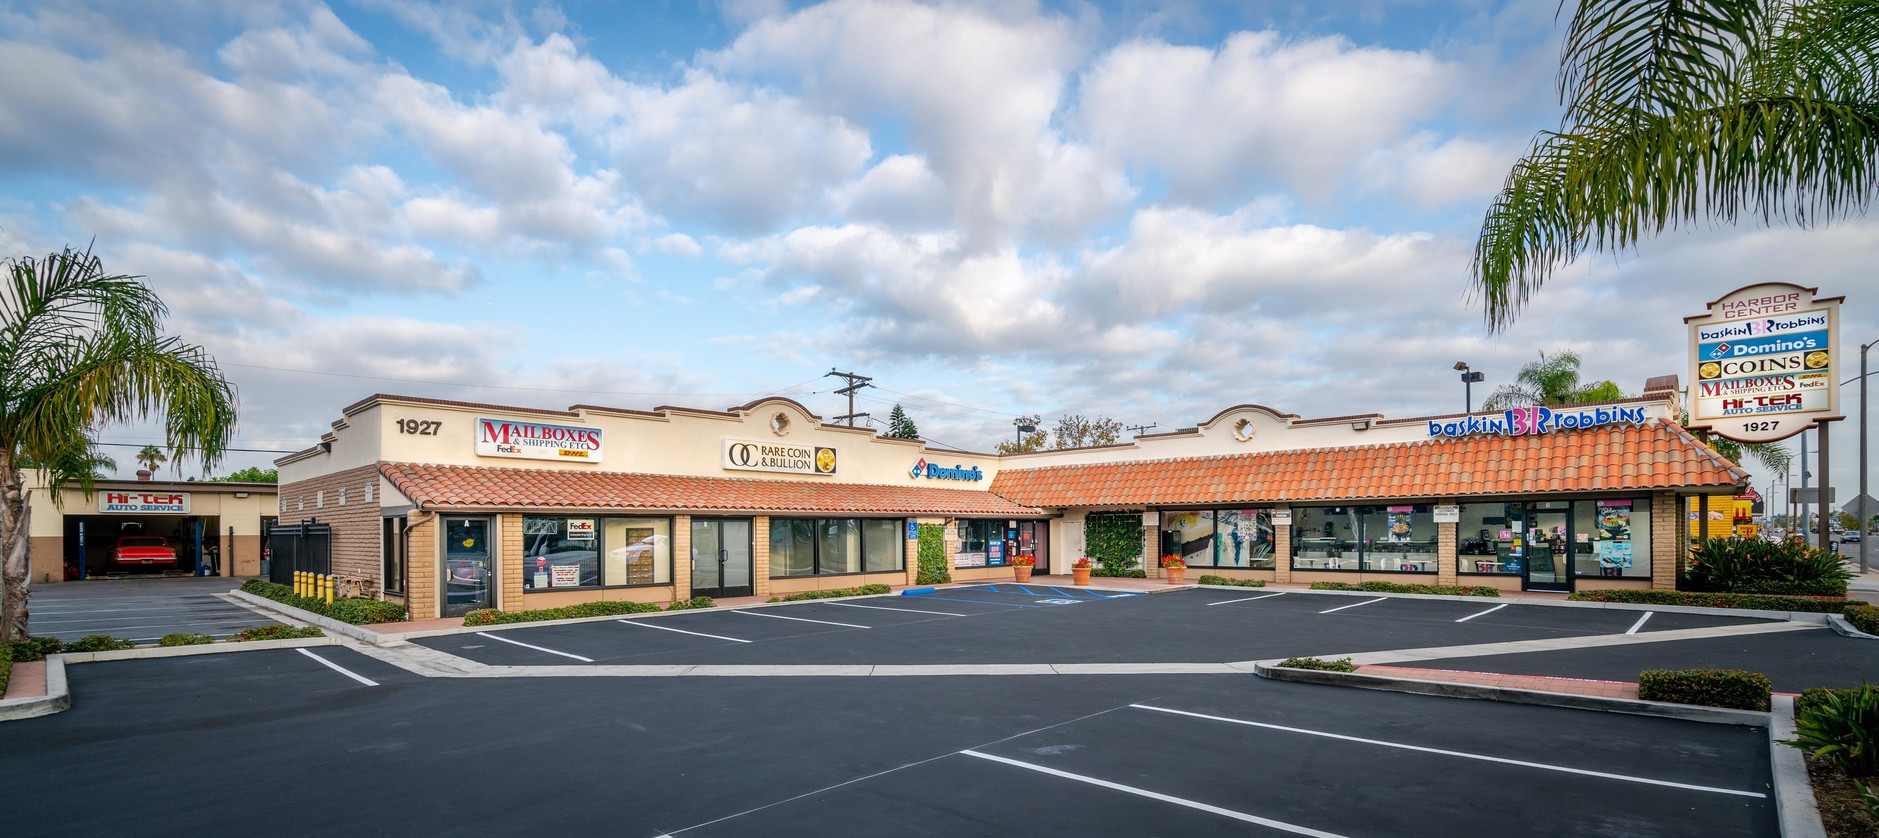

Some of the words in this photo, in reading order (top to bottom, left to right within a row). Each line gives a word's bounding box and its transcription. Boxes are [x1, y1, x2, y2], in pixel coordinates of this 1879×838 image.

[1722, 292, 1800, 311] HARBOR
[1725, 302, 1797, 319] CENTER
[1700, 327, 1746, 340] baskin
[1746, 319, 1775, 336] BR
[1775, 315, 1826, 331] robbins
[1733, 336, 1817, 356] Domino's
[1723, 355, 1801, 375] COINS
[1700, 374, 1796, 397] MAILBOXES
[1730, 385, 1766, 395] SHIPPING
[1800, 380, 1825, 388] FedEx
[1722, 407, 1753, 415] AUTO
[1756, 403, 1803, 413] SERVICE
[396, 418, 443, 436] 1927
[1428, 415, 1503, 437] baskin
[1504, 406, 1551, 436] BR
[1553, 405, 1646, 430] robbins
[1743, 421, 1780, 432] 1927
[481, 421, 600, 451] MAILBOXES
[512, 437, 521, 446] &
[522, 438, 567, 449] SHIPPING
[497, 444, 522, 454] FedEx
[728, 442, 758, 468] OC
[761, 446, 785, 457] RARE
[787, 448, 811, 459] COIN
[770, 457, 811, 470] BULLION
[927, 463, 983, 481] Domino's
[140, 504, 184, 512] SERVICE
[524, 521, 556, 534] OPEN
[570, 522, 592, 530] FedEx
